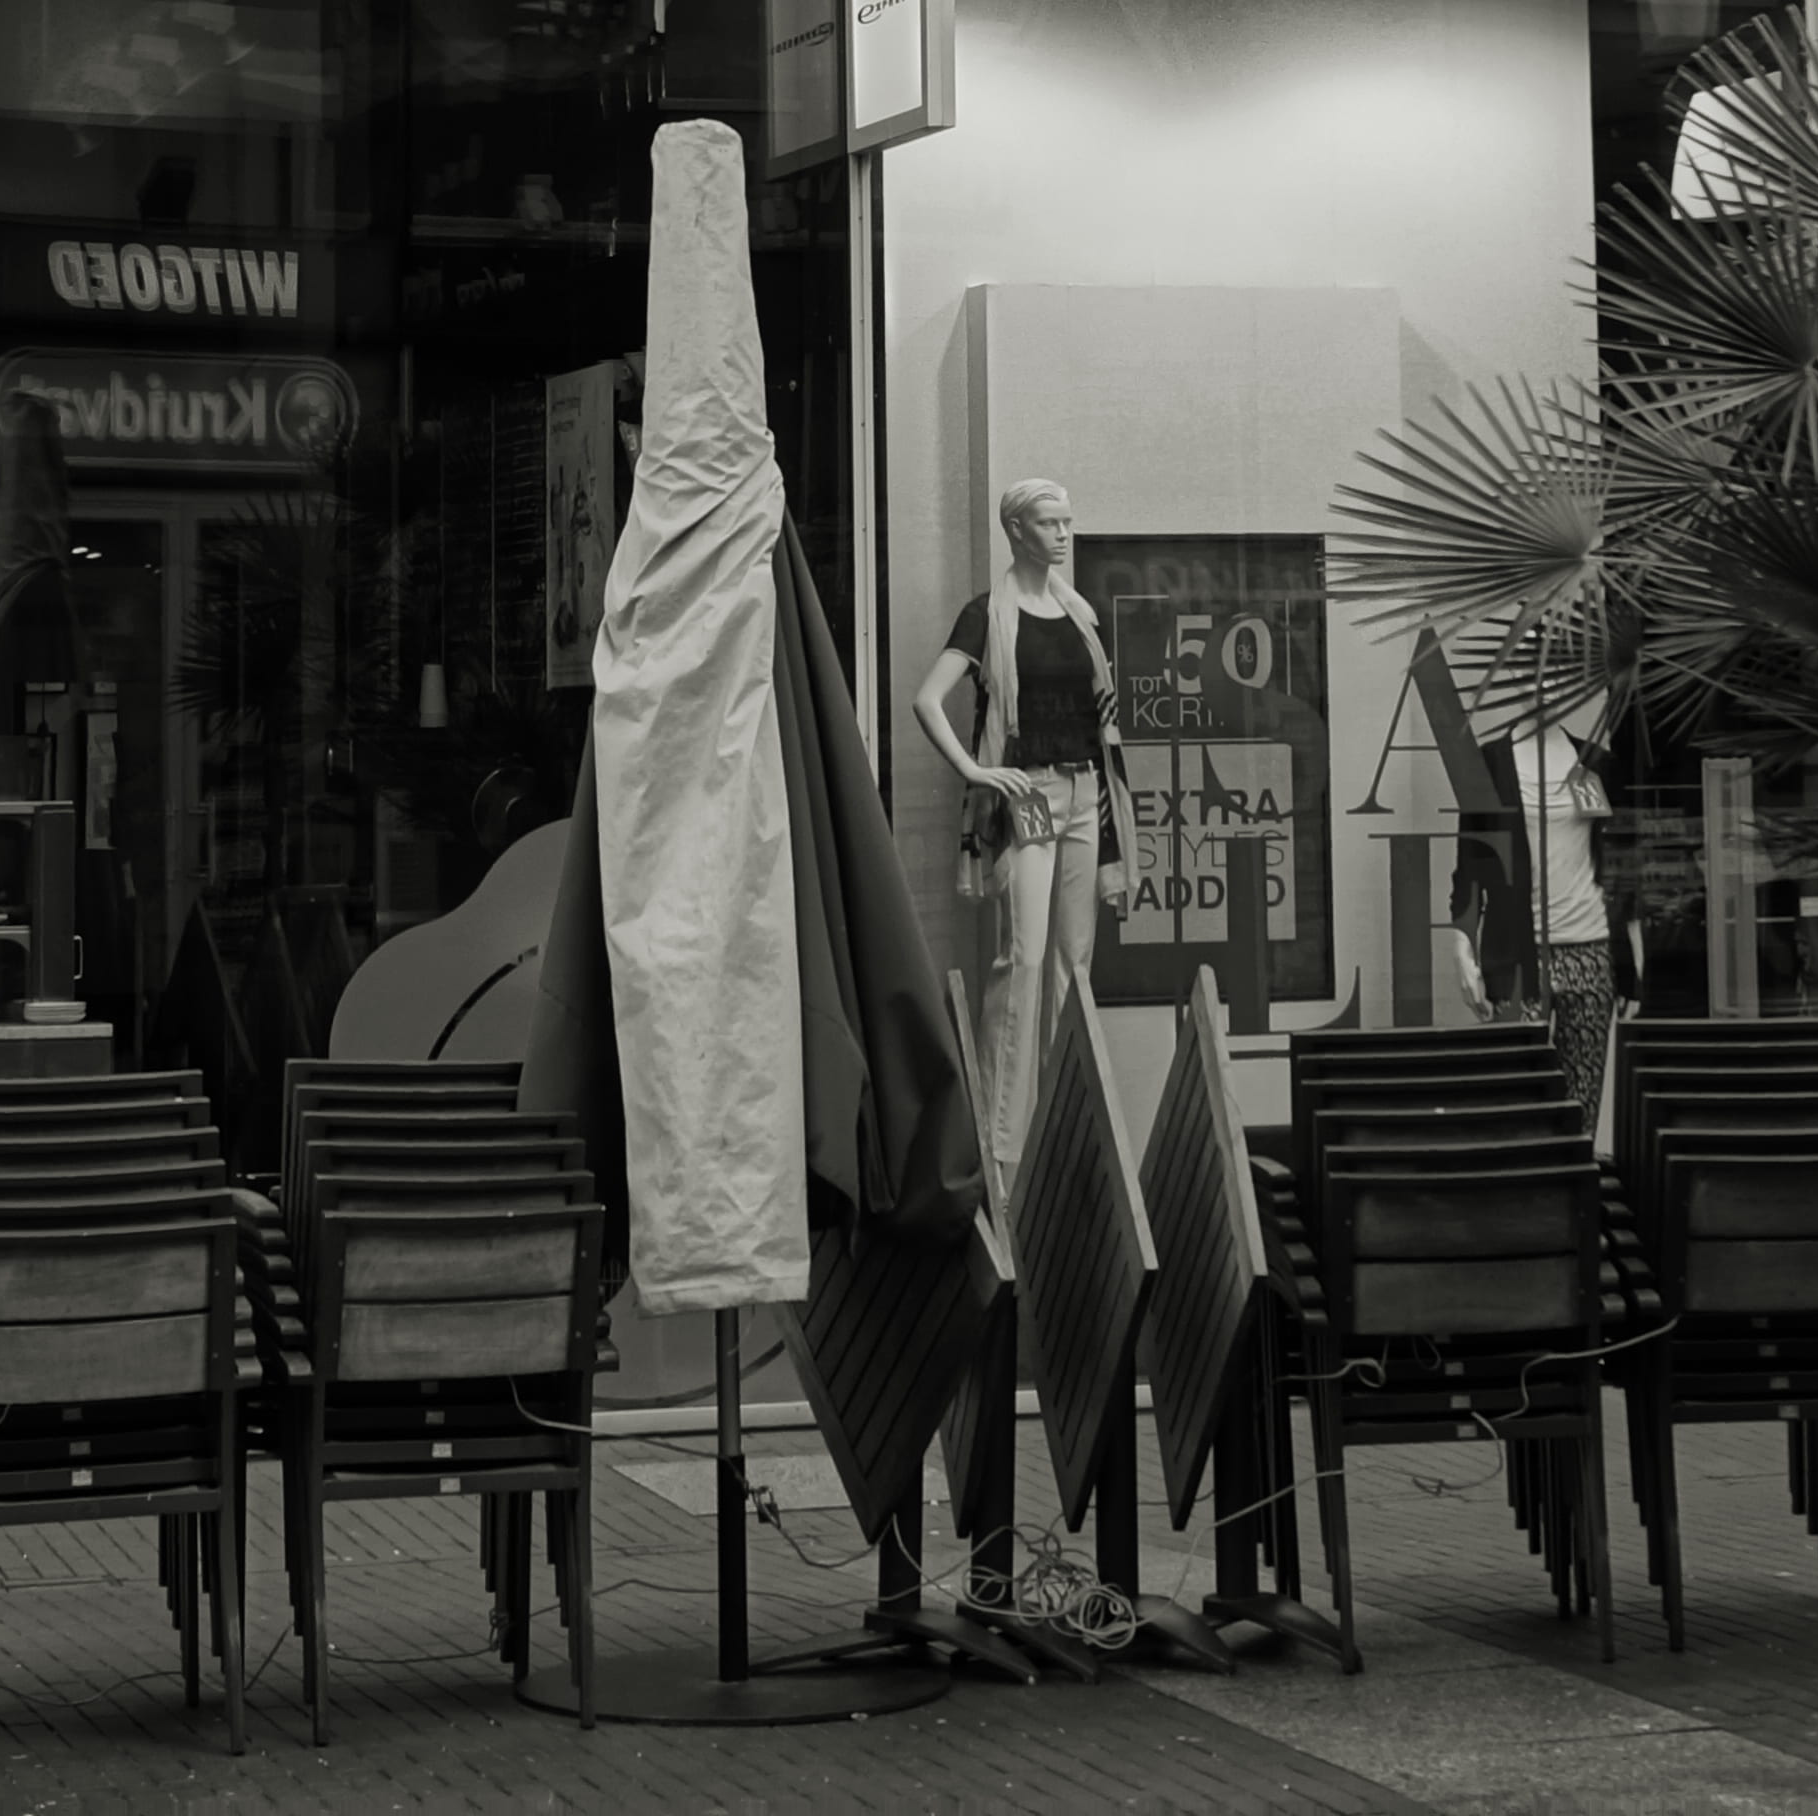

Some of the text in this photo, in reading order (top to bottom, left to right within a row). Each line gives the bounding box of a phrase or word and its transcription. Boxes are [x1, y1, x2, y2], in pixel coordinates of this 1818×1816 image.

[1130, 676, 1165, 696] TOT
[1135, 831, 1286, 870] STYLS
[1133, 875, 1286, 912] ADDD
